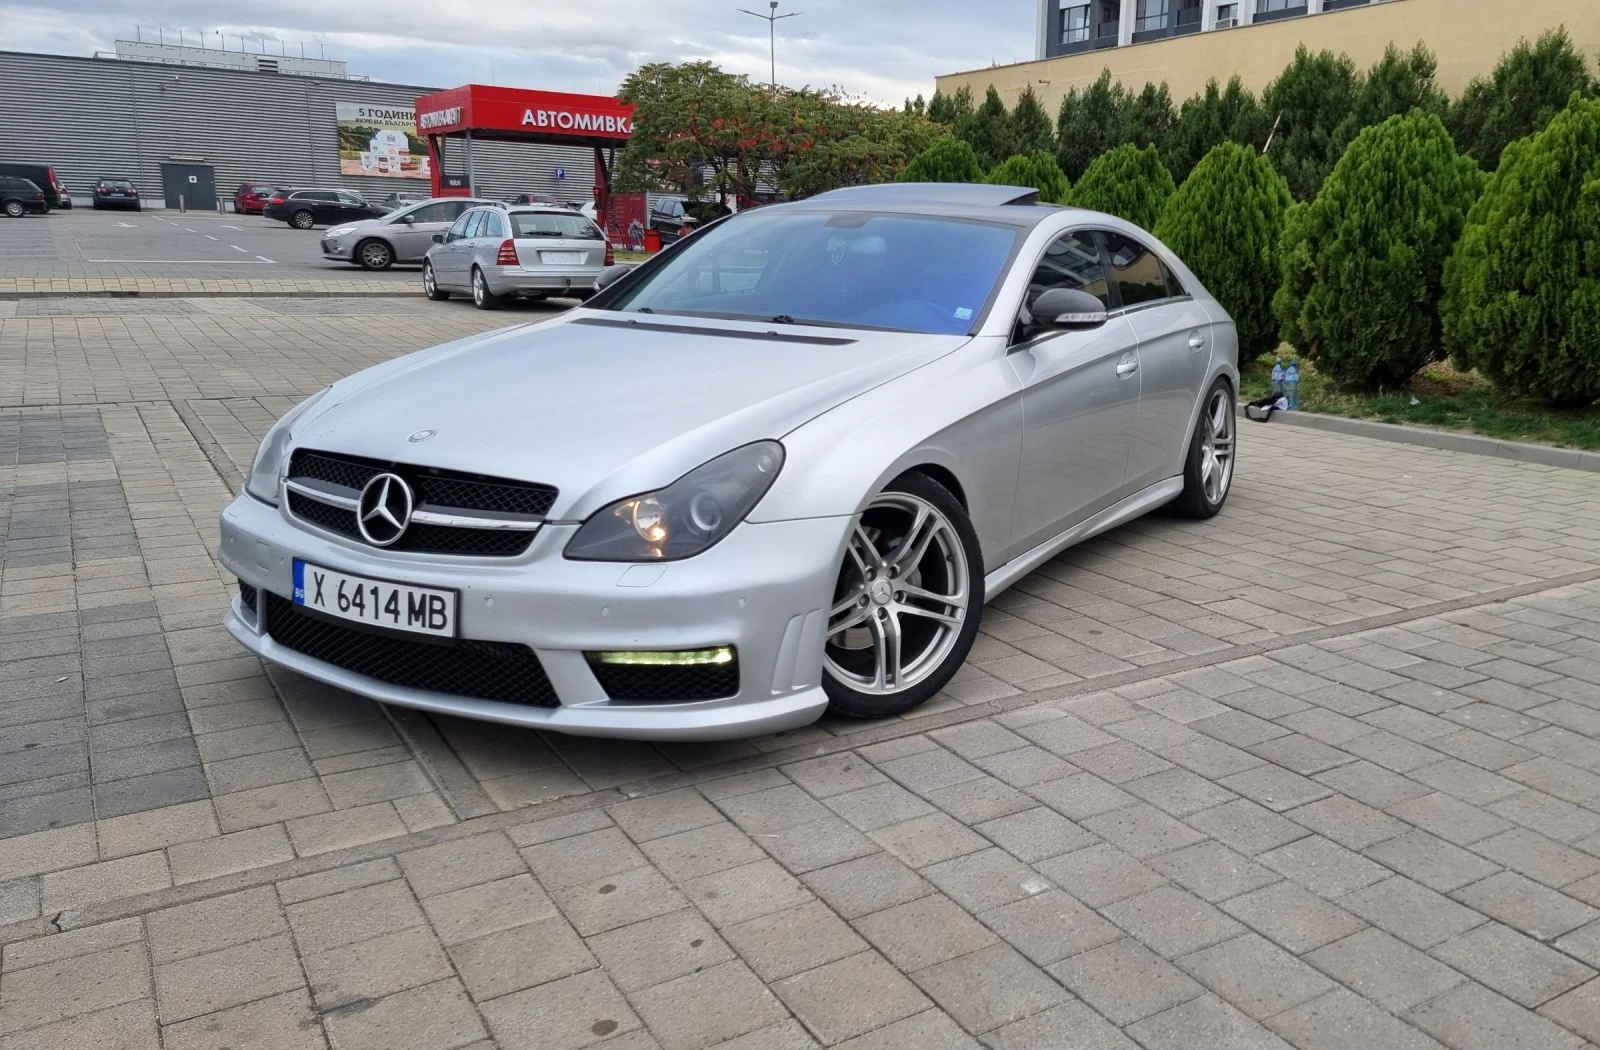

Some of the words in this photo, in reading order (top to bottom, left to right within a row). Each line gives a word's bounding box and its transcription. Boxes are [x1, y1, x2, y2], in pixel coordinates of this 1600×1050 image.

[359, 108, 365, 117] 5
[368, 108, 417, 121] ГОДИНИ
[521, 109, 637, 133] АВТОМИВКА
[295, 587, 304, 599] BG
[313, 571, 326, 607] X
